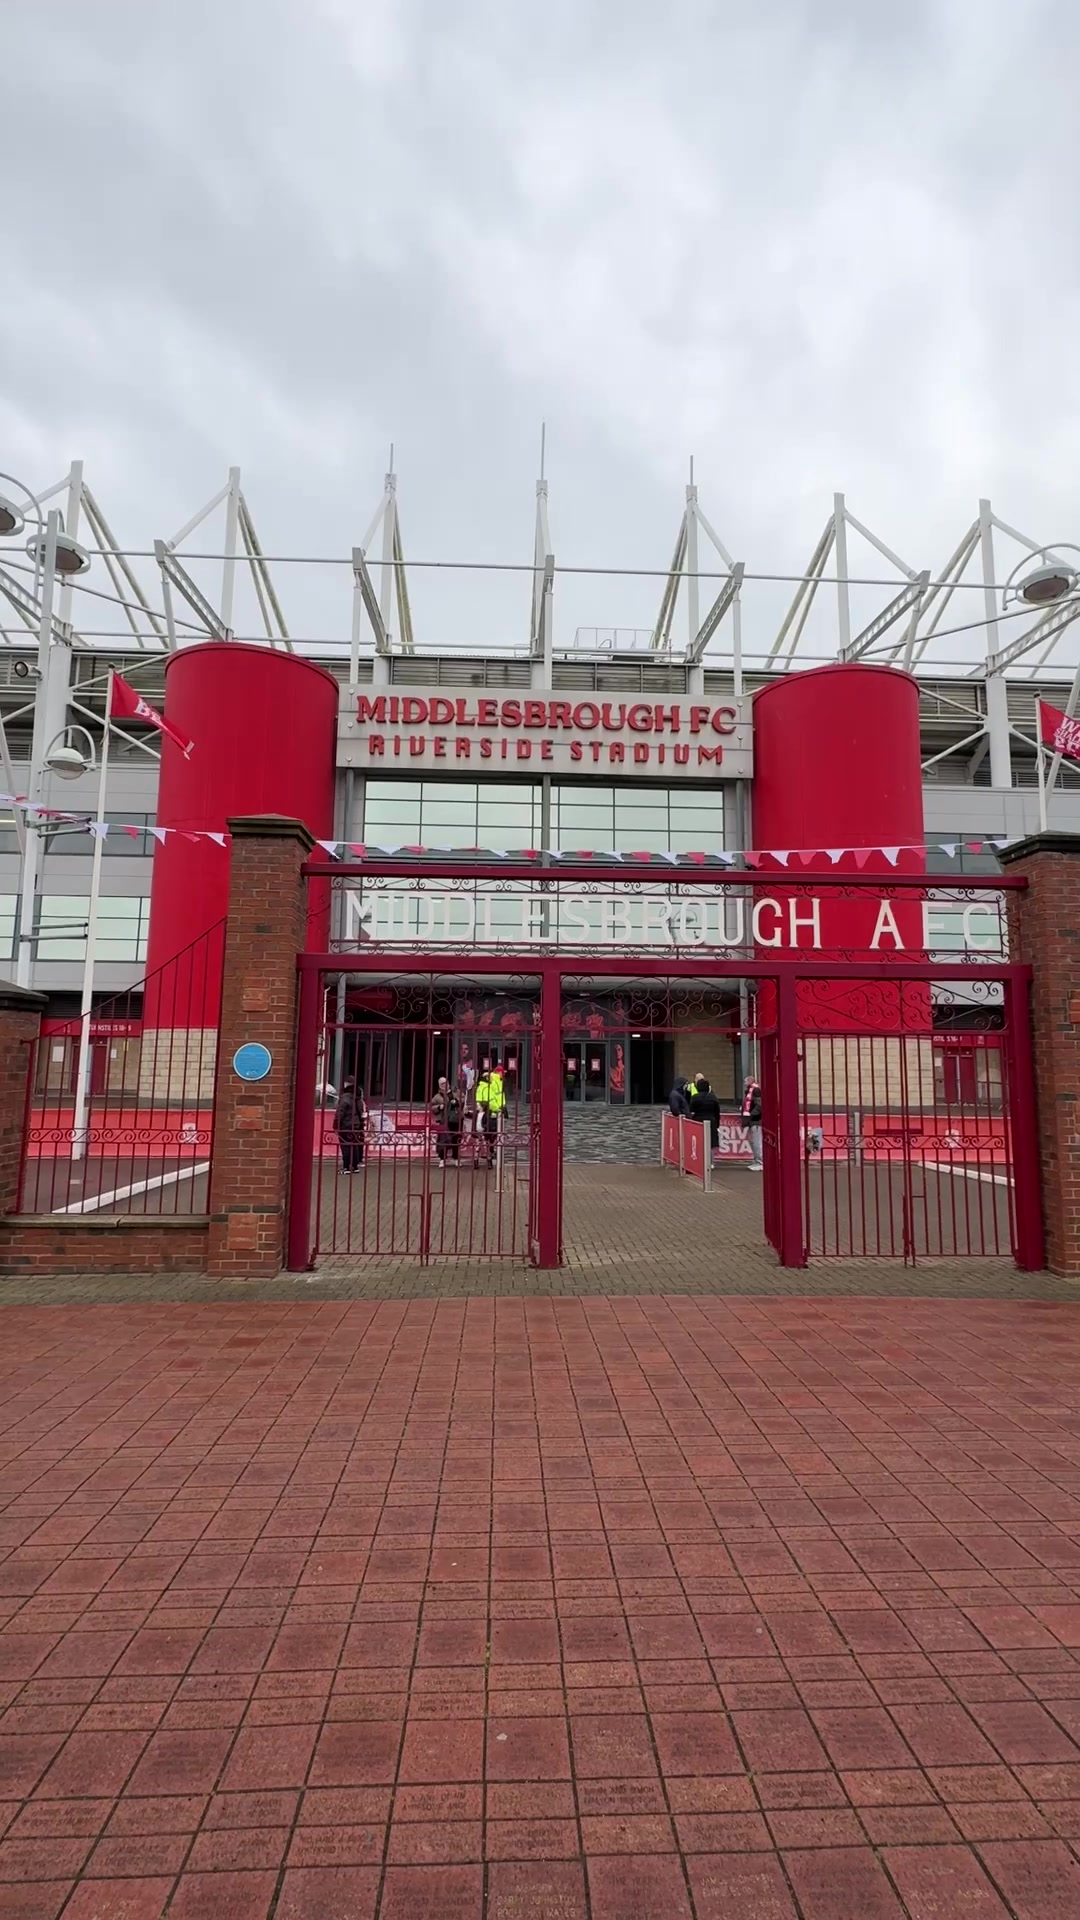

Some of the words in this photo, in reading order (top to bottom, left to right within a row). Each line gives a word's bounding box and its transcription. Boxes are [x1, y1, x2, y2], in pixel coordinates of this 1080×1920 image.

[356, 696, 681, 732] MIDDLESBROUGH
[690, 706, 737, 735] FC
[368, 734, 554, 760] RIVERSIDE
[570, 741, 723, 765] STADIUM
[344, 889, 822, 949] MIDDLESBROUGH
[869, 899, 994, 950] AFC
